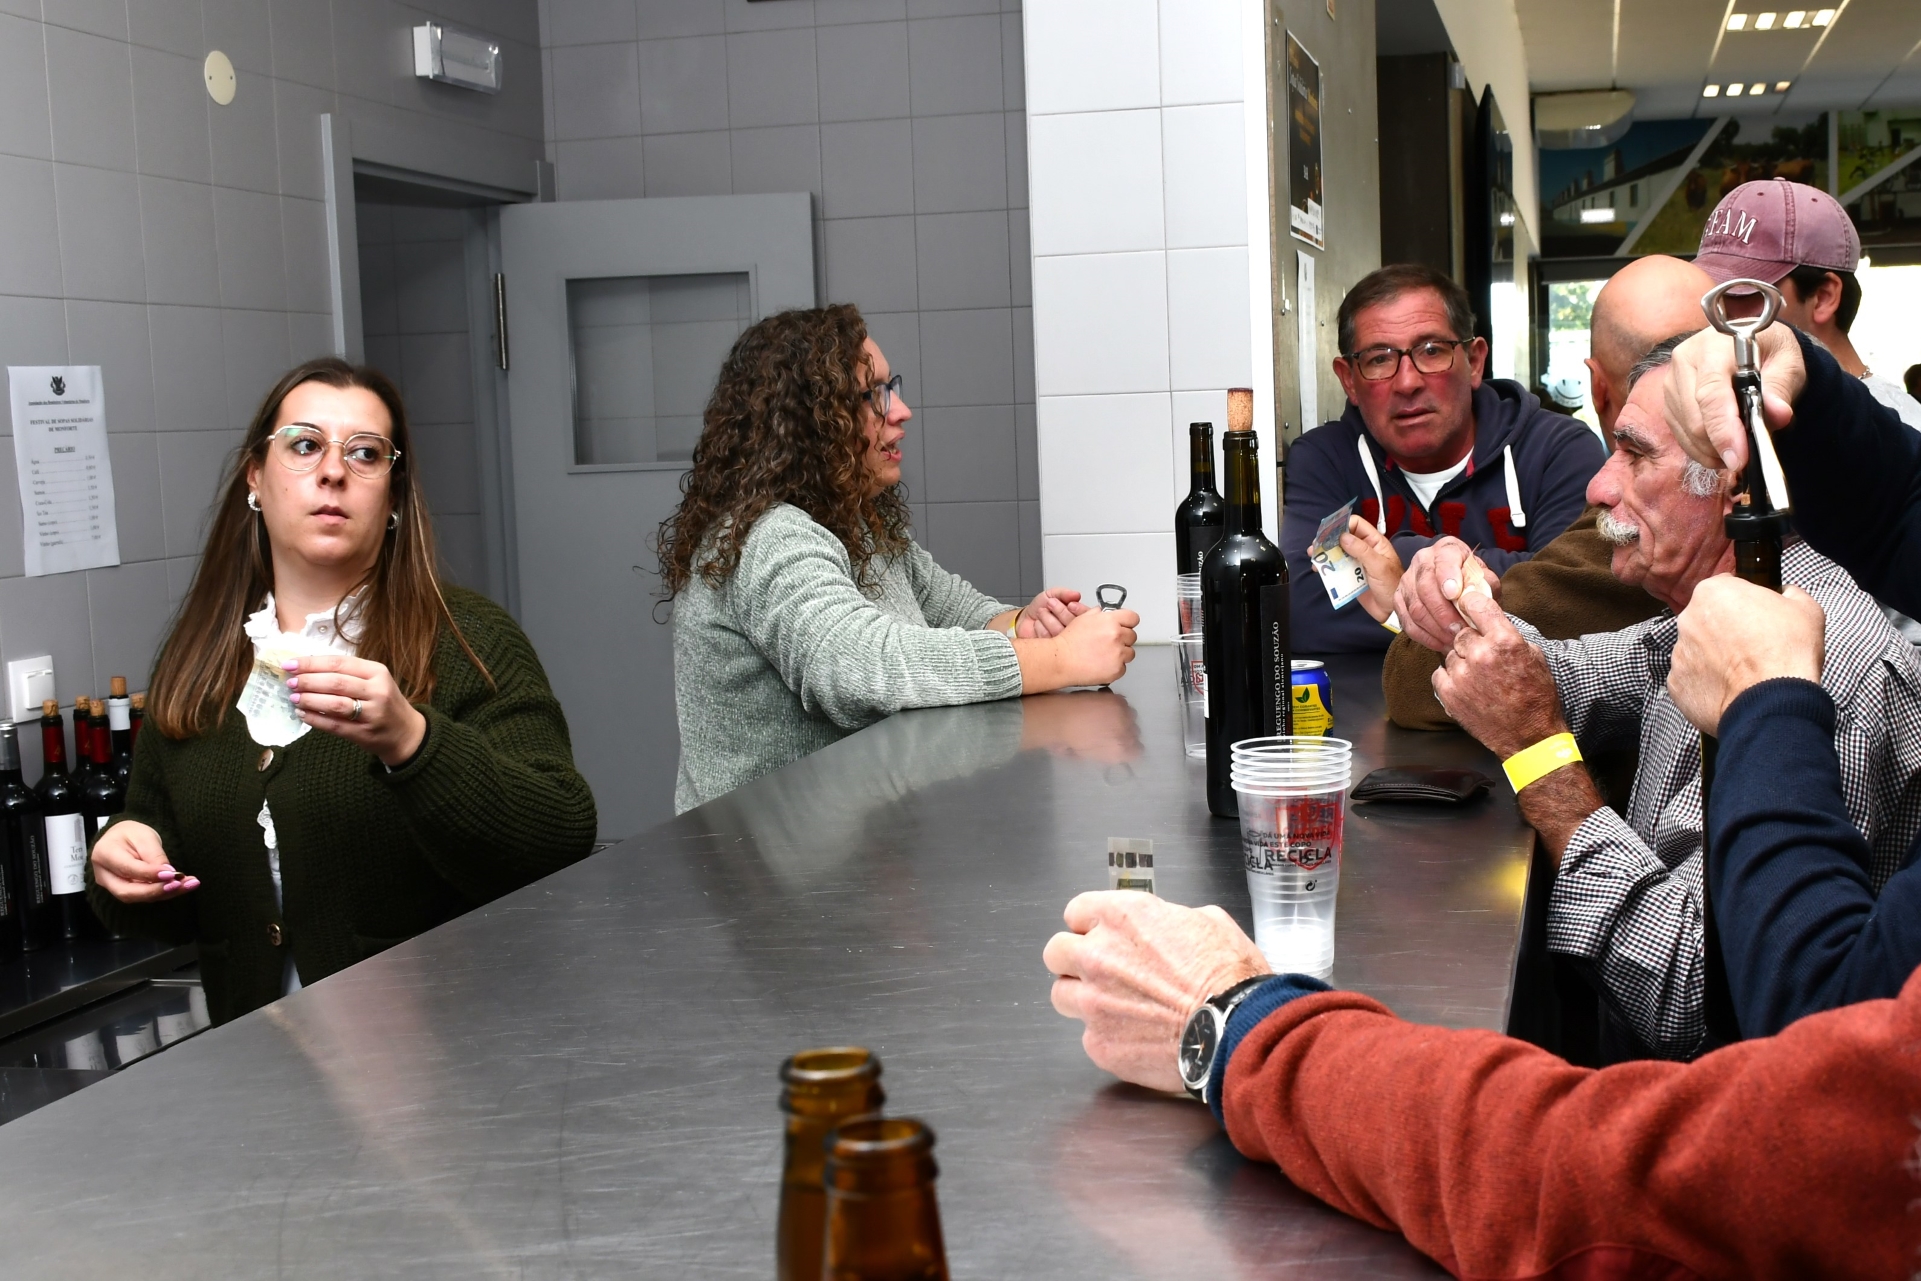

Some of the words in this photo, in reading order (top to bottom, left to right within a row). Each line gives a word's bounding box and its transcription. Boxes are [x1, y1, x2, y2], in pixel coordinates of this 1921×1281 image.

[1704, 208, 1757, 244] FAM
[1313, 551, 1336, 577] 20
[1354, 566, 1365, 583] 20
[1272, 622, 1280, 663] SOUZÃO
[1274, 665, 1280, 681] DO
[1274, 683, 1282, 737] REGUENGO
[1264, 846, 1332, 862] RECICLA
